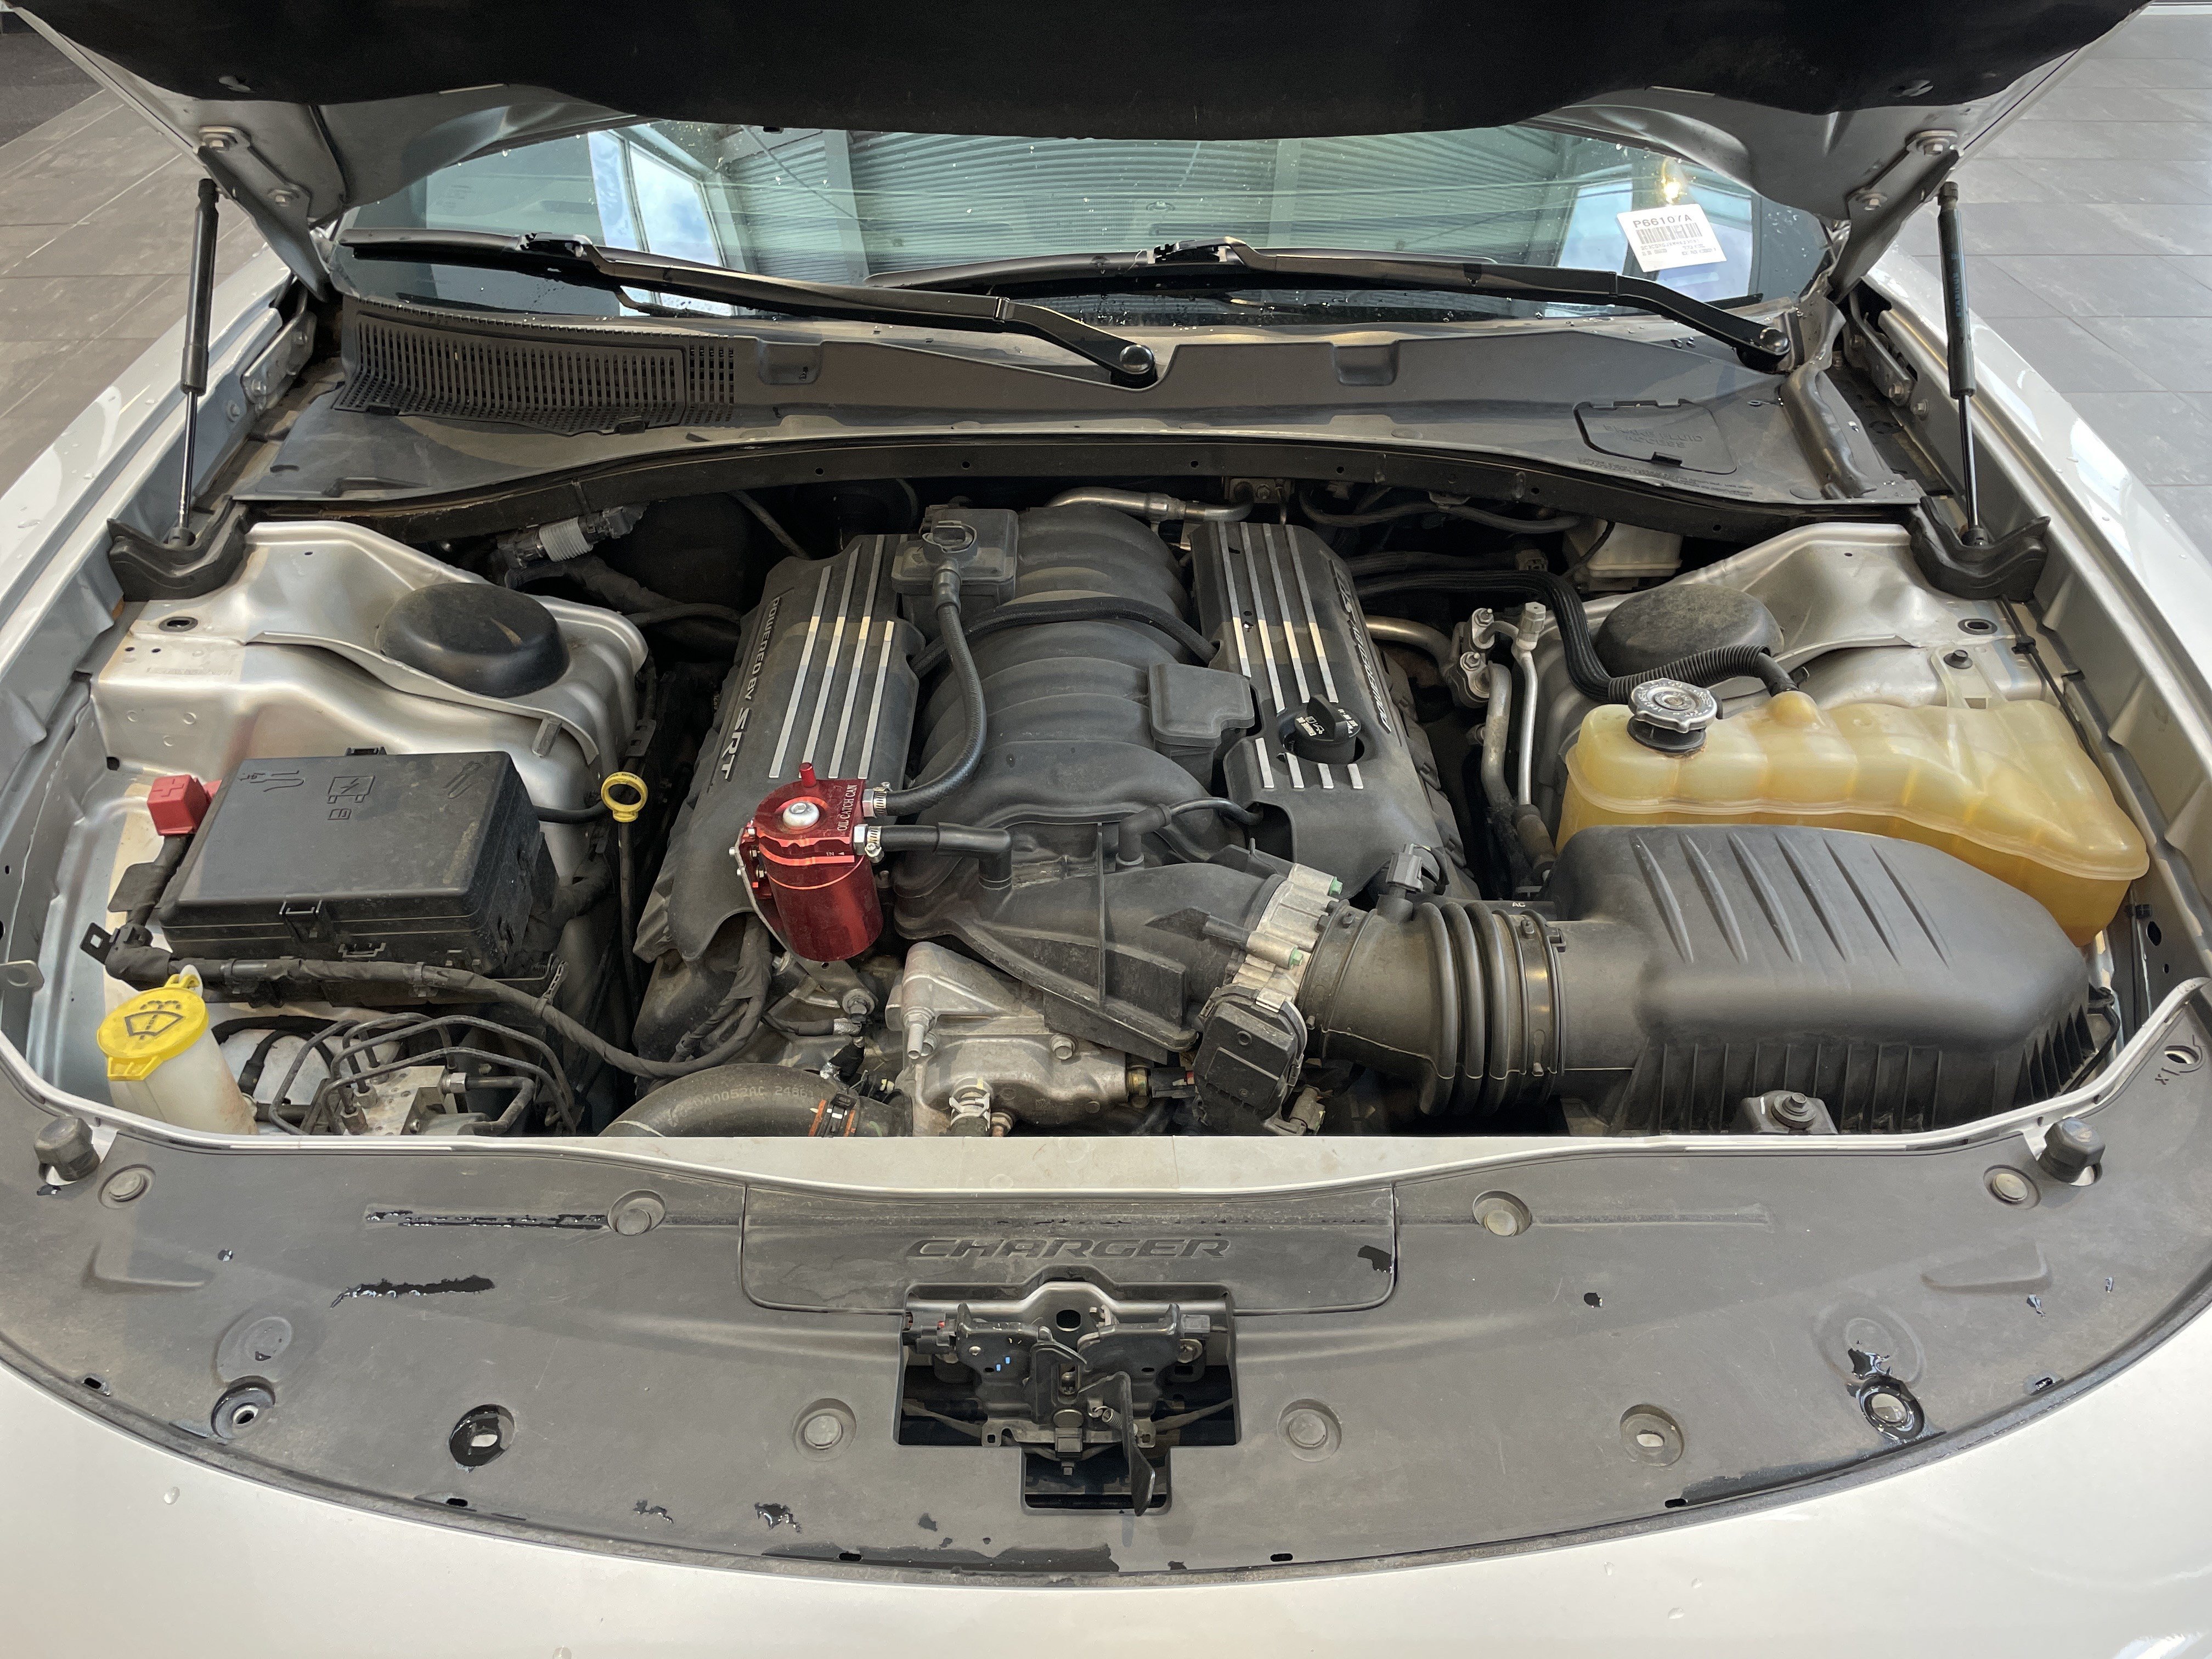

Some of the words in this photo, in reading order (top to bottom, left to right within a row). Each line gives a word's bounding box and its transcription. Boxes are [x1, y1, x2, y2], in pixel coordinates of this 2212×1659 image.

[1632, 214, 1692, 229] P66107A
[752, 596, 781, 675] POWERED
[744, 676, 757, 700] BY
[1357, 644, 1392, 733] POWERED
[720, 707, 750, 780] SRT
[845, 785, 857, 798] CAN
[840, 798, 855, 819] CATCH
[837, 820, 849, 831] OIL
[906, 1238, 1231, 1259] CHARGER
